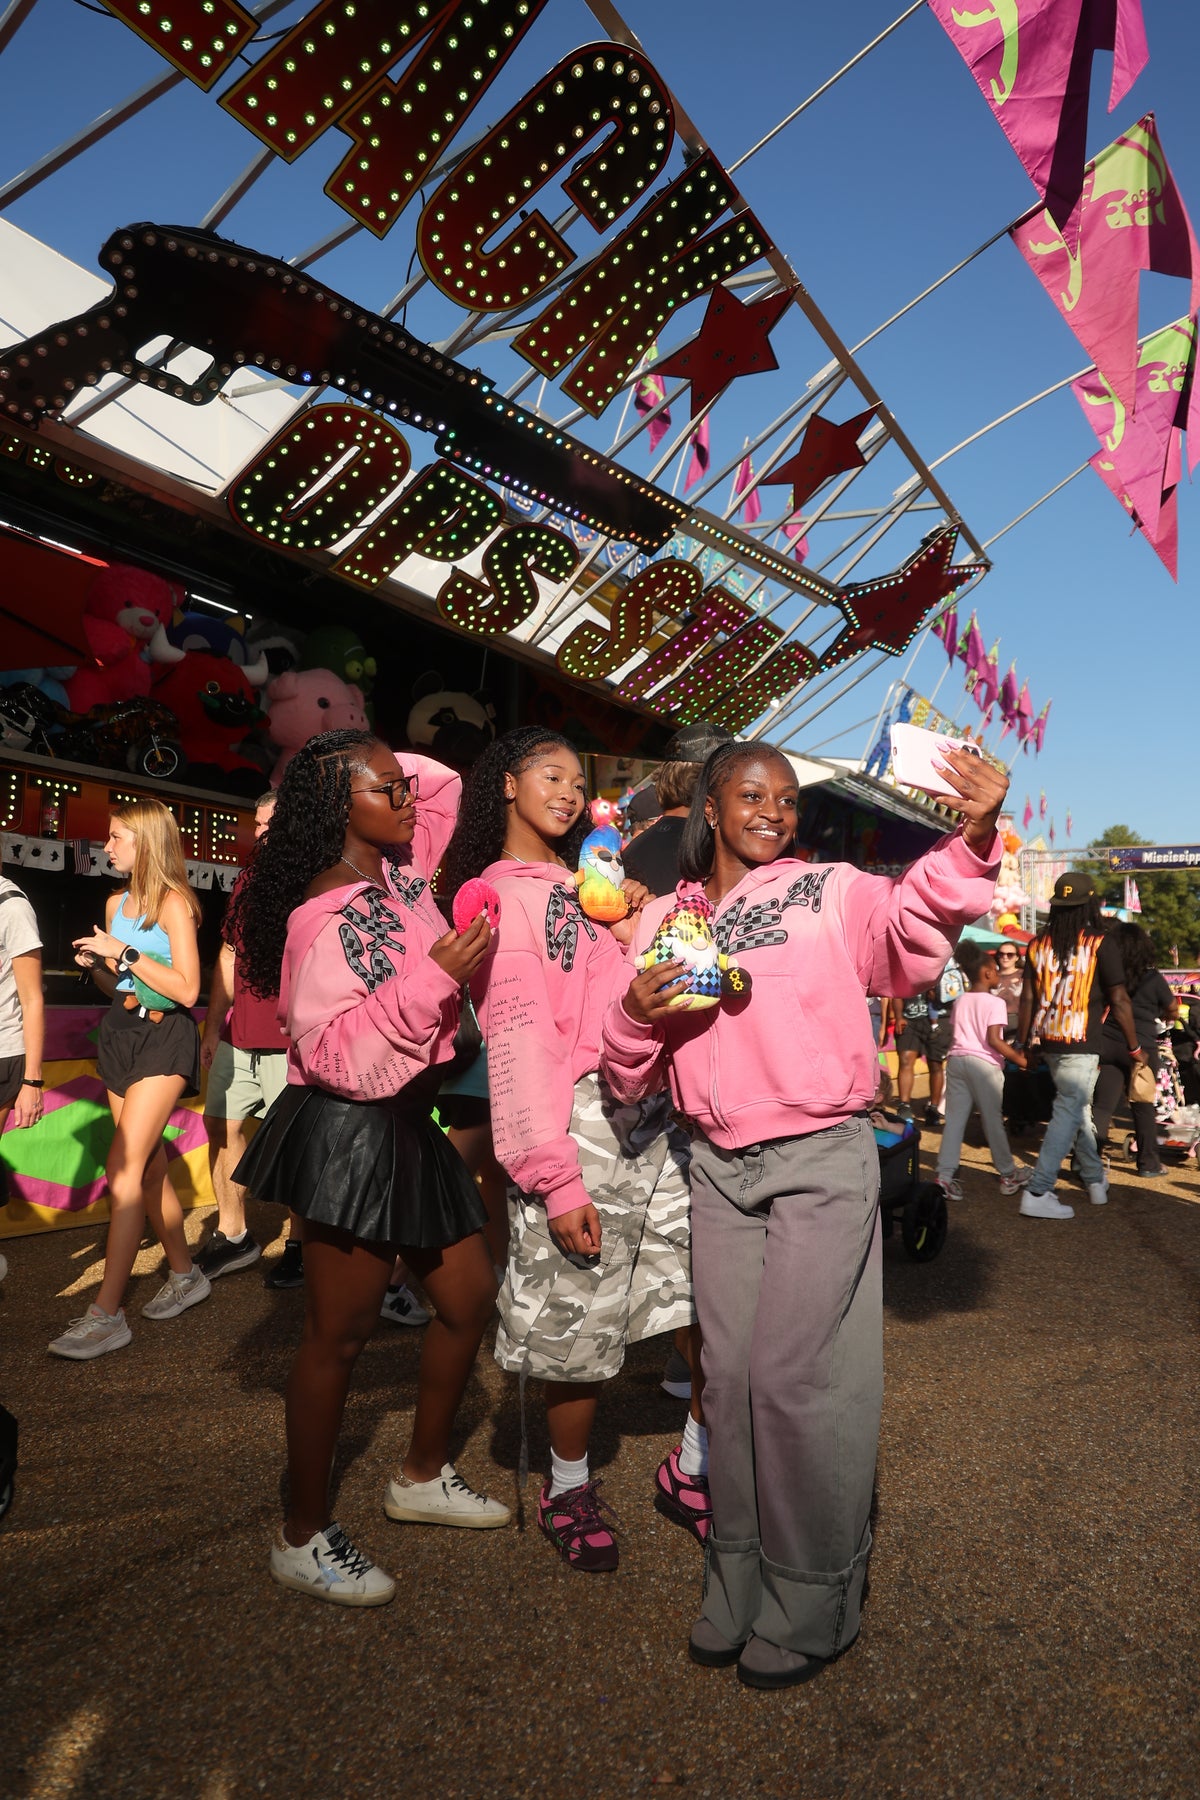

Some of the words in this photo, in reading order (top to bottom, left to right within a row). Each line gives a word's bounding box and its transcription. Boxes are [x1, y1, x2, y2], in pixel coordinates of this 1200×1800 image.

[107, 0, 774, 418] ACK
[227, 403, 580, 636] OPS
[109, 789, 239, 866] HE
[776, 866, 834, 913] 24
[1063, 885, 1073, 897] P
[1036, 945, 1091, 974] WOEN
